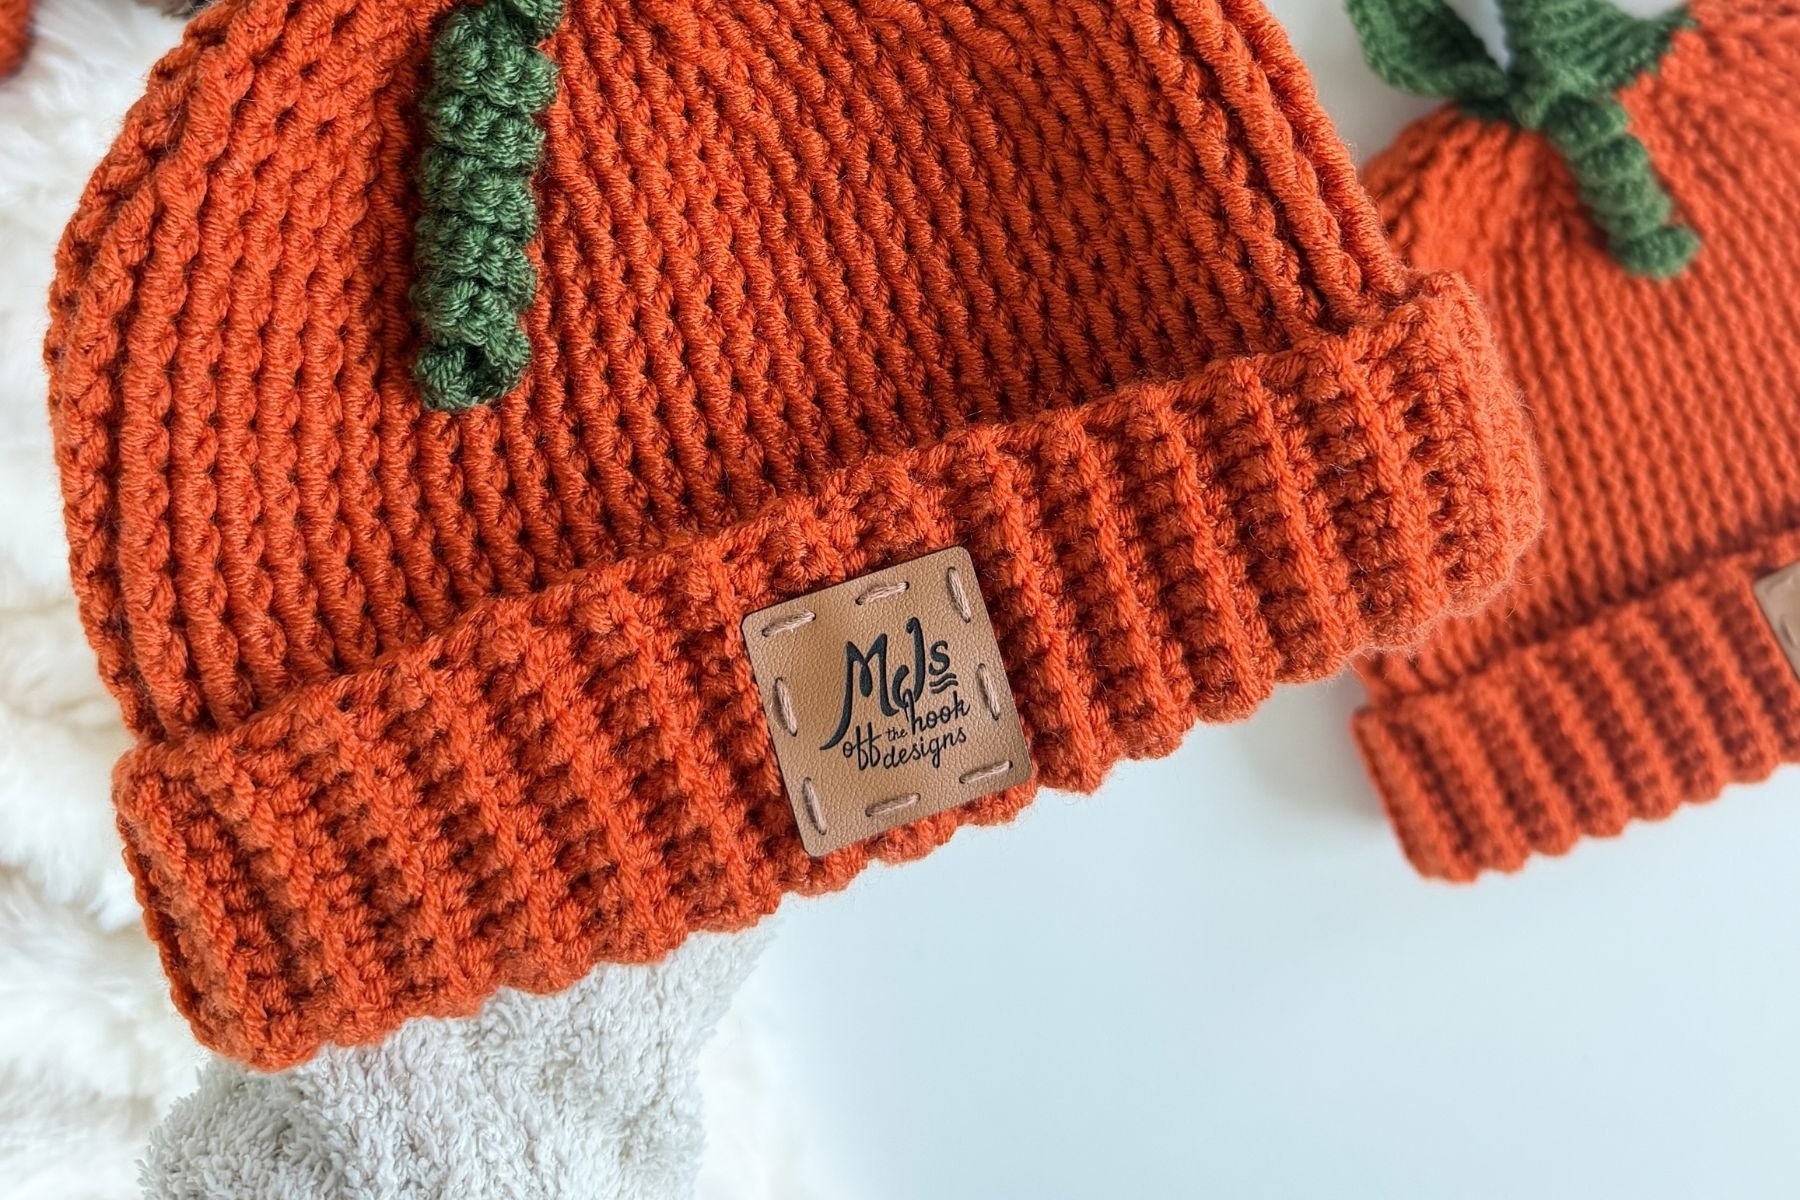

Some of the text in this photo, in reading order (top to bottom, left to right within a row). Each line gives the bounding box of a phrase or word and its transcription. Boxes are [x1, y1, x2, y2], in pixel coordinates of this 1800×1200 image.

[842, 688, 971, 771] off the hook
[883, 726, 967, 770] designs
